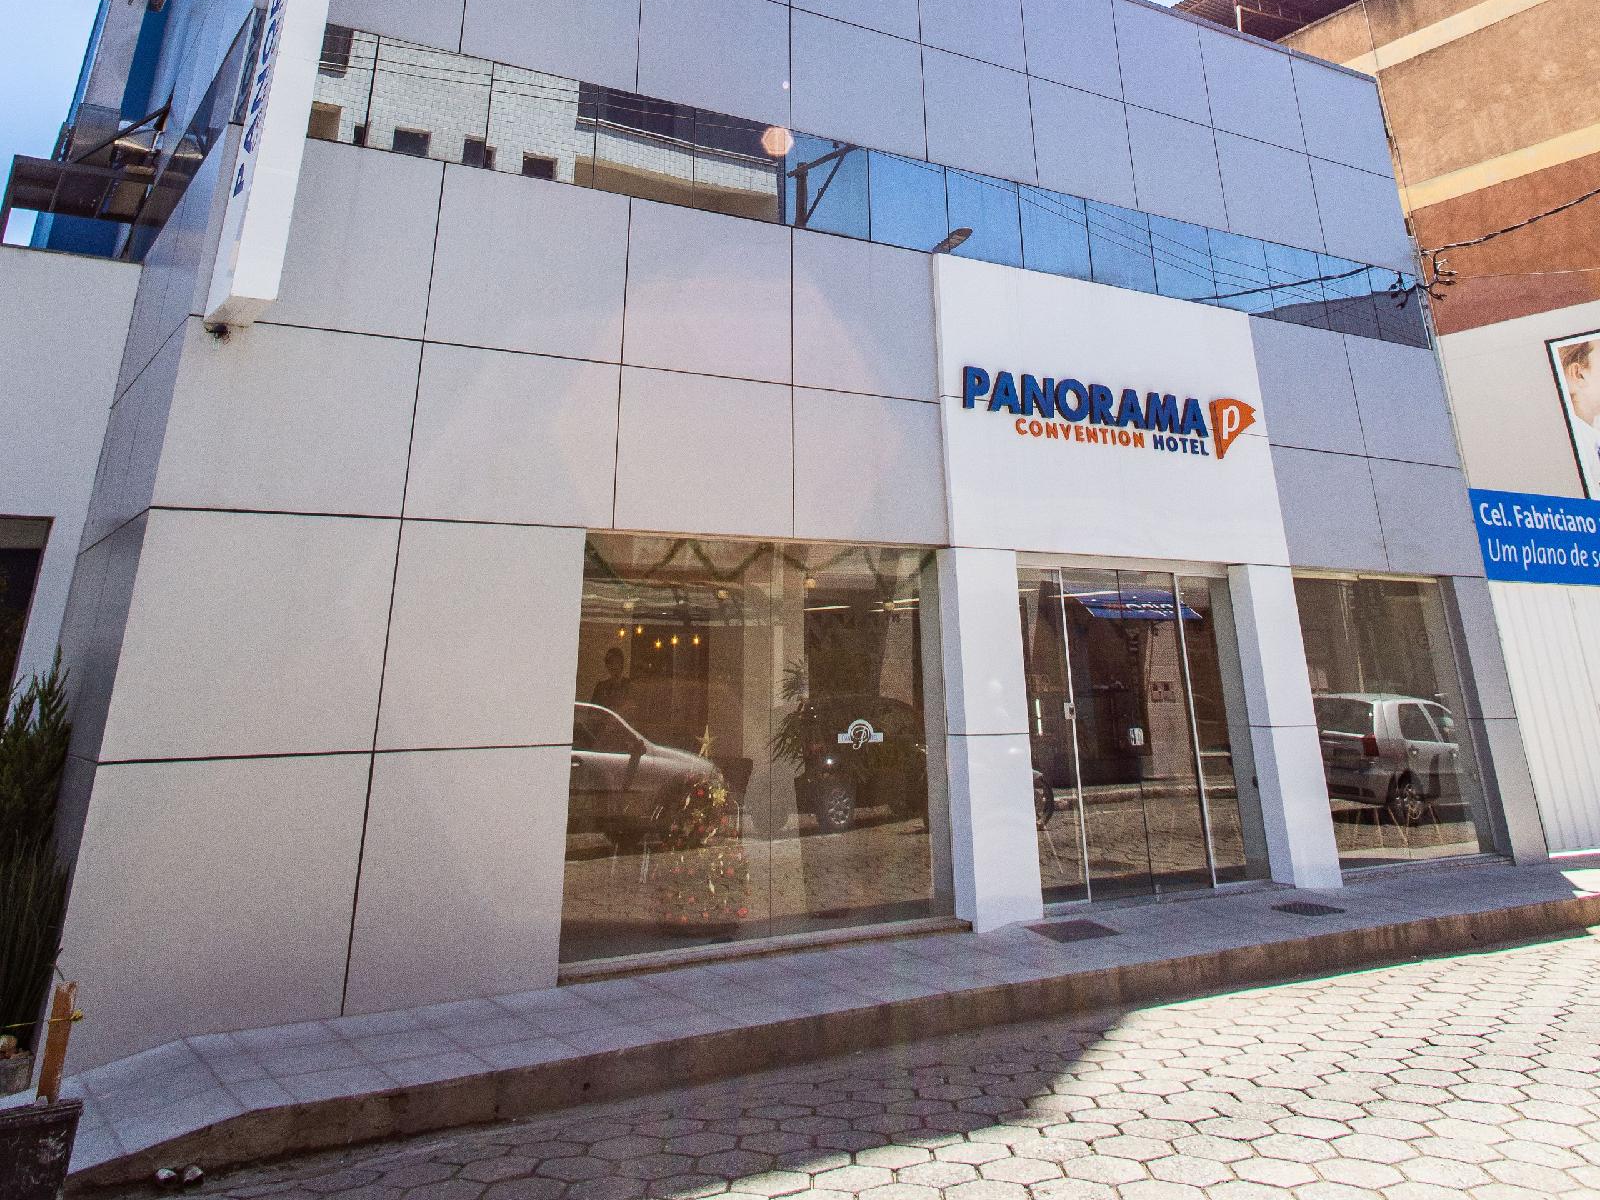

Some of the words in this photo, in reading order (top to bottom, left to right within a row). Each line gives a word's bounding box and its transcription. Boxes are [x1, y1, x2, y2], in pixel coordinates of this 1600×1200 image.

[962, 365, 1208, 438] PANORAMA
[1015, 418, 1145, 448] CONVENTION
[1153, 434, 1209, 456] HOTEL
[1480, 502, 1512, 527] Cel.
[1513, 505, 1597, 533] Fabriciano
[1488, 538, 1518, 563] Um
[1522, 539, 1567, 571] plano
[1570, 542, 1589, 567] de
[1591, 550, 1600, 568] s
